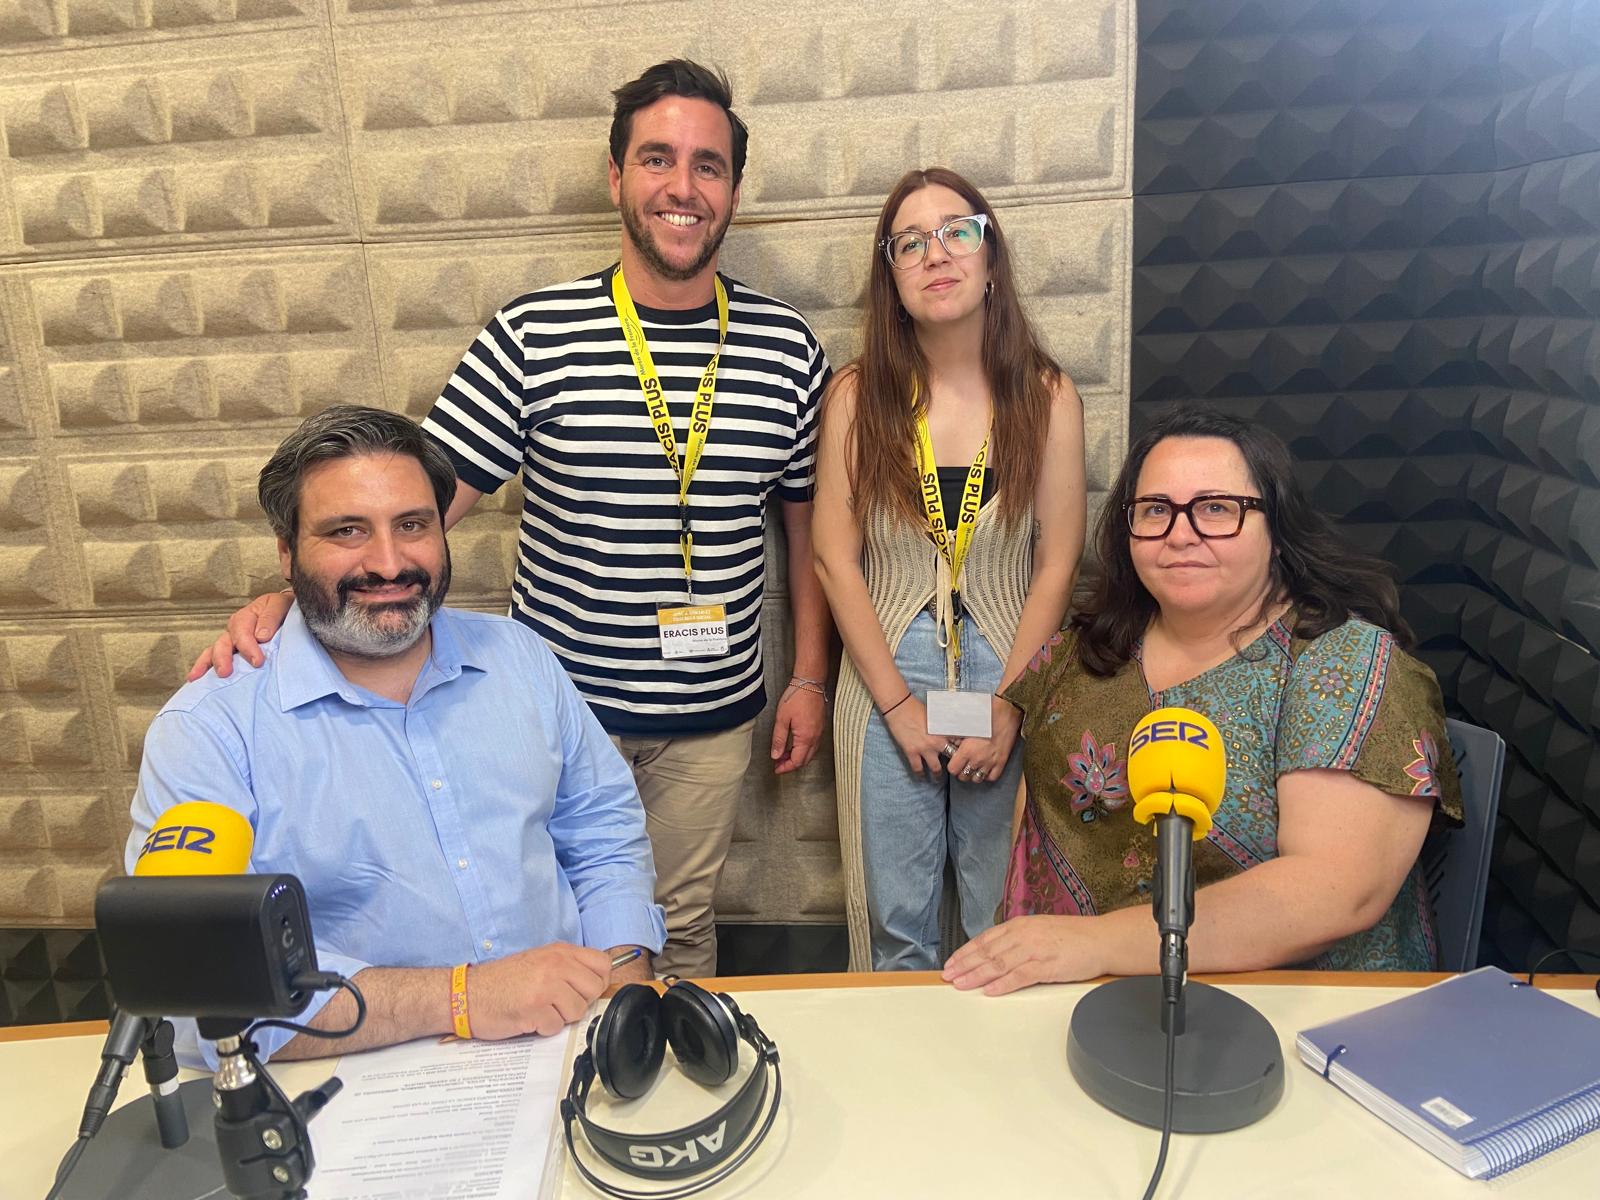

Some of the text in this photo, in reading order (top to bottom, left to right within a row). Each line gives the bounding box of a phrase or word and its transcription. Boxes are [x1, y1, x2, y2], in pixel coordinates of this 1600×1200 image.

[644, 378, 666, 419] PLUS
[693, 360, 717, 433] CIS PLUS
[923, 473, 941, 514] PLUS
[962, 483, 979, 523] PLUS
[663, 626, 724, 638] ERACIS PLUS
[1130, 721, 1209, 757] SER
[138, 826, 215, 860] SER
[628, 1120, 727, 1168] AKG
